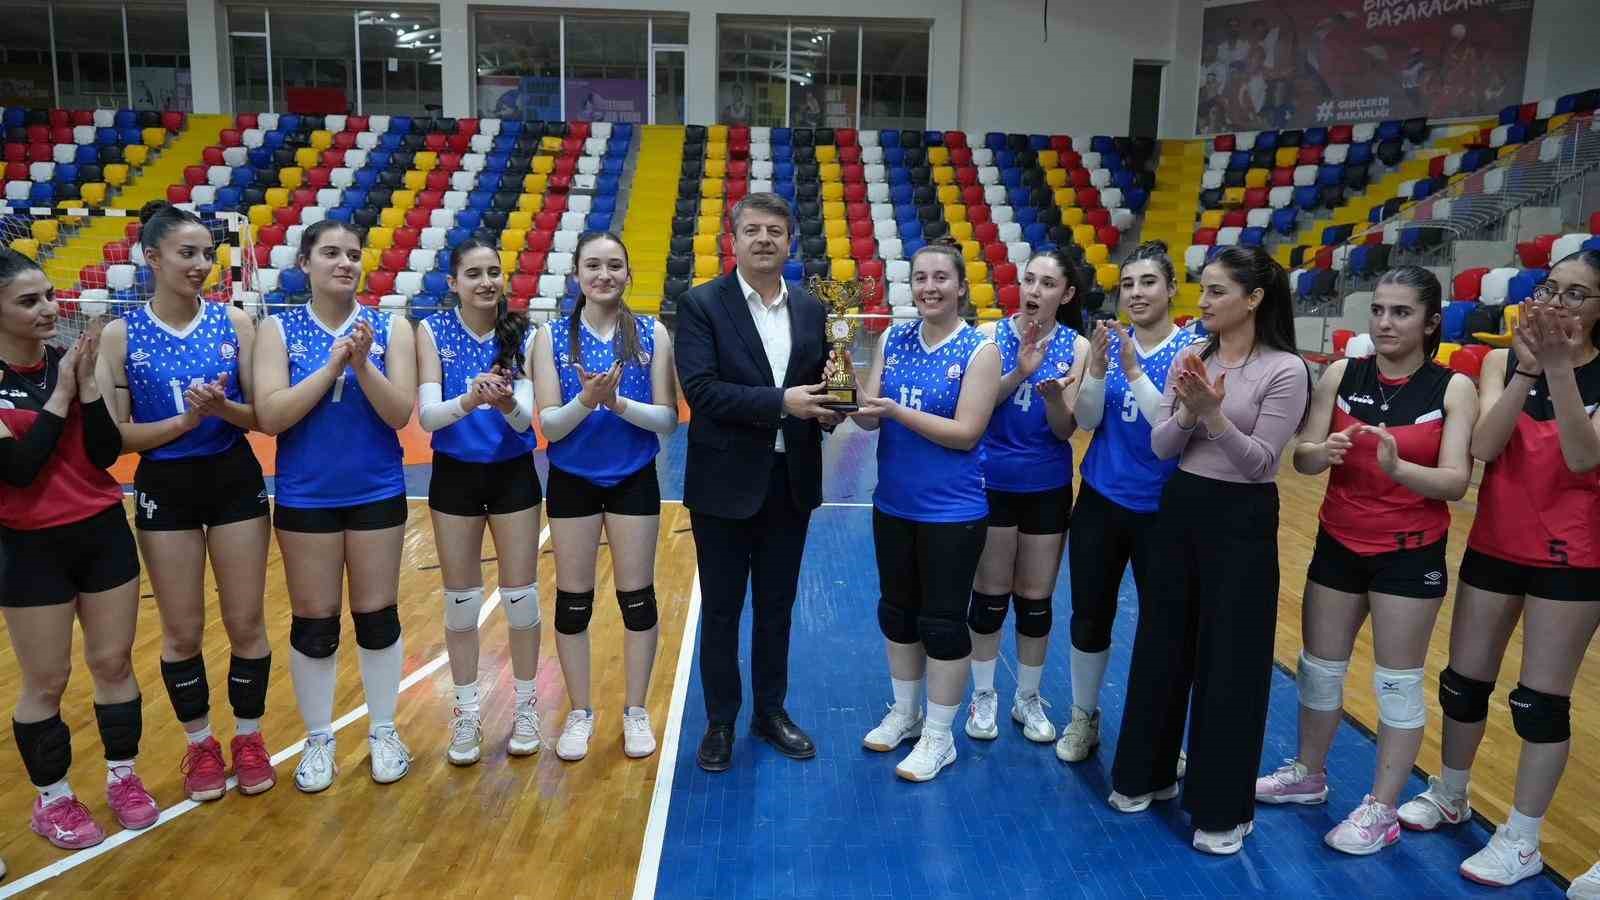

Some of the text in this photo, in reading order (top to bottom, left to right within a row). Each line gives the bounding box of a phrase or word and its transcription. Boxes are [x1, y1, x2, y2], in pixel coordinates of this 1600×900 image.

[1014, 382, 1032, 412] 4
[1121, 391, 1138, 423] 5
[1548, 540, 1568, 565] 5
